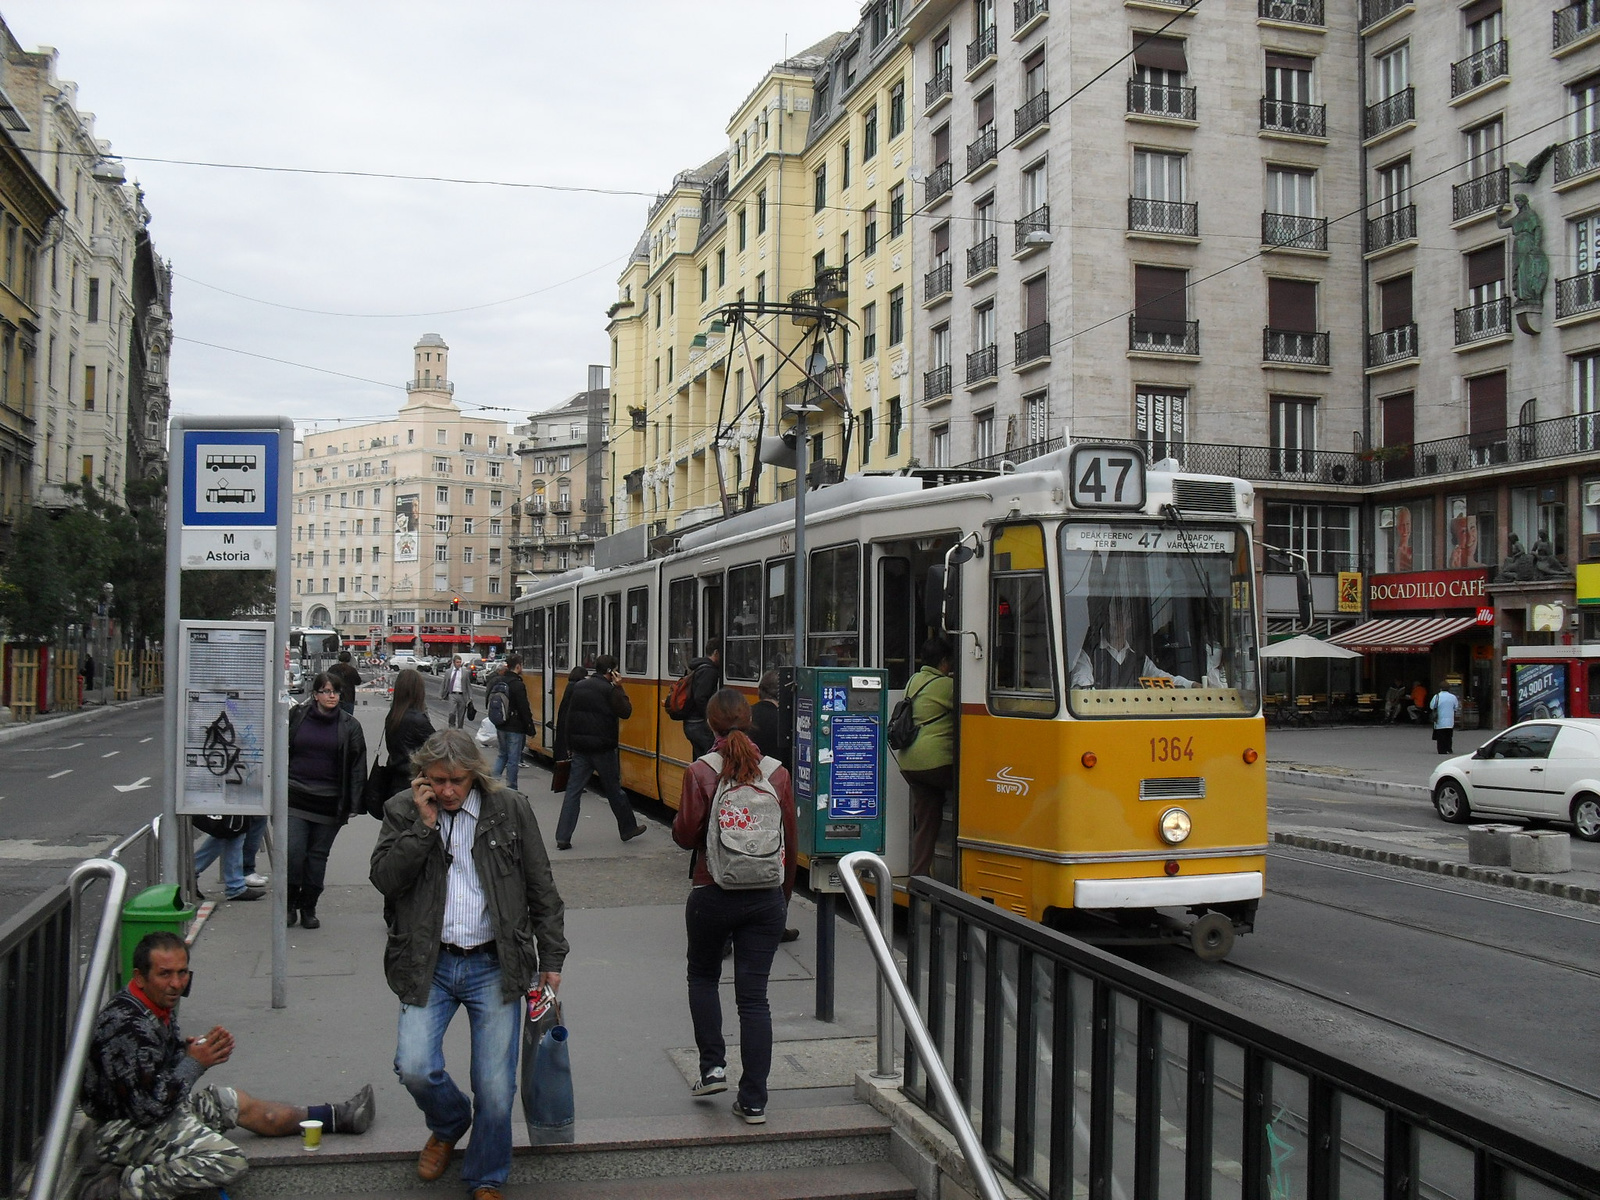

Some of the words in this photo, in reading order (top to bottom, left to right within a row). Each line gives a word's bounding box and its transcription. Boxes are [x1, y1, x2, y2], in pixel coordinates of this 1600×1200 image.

[1135, 394, 1147, 432] REKLÁM
[1155, 395, 1165, 433] GRAFIKA
[1079, 457, 1133, 502] 47
[223, 533, 235, 545] M
[1080, 531, 1101, 540] DEÁK
[1103, 532, 1133, 540] FERENC
[1137, 532, 1162, 549] 47
[1176, 533, 1216, 543] BUDAFOK,
[1094, 539, 1109, 548] TÉR
[1167, 540, 1209, 550] VÁROSHÁZ
[1210, 542, 1225, 550] TÉR
[206, 550, 250, 561] Astoria
[1370, 581, 1446, 600] BOCADILLO
[1449, 576, 1485, 597] CAFÉ
[1477, 609, 1494, 624] illy
[1518, 686, 1529, 701] 24
[1528, 678, 1543, 696] 900
[1149, 736, 1194, 762] 1364
[996, 784, 1010, 794] BKV
